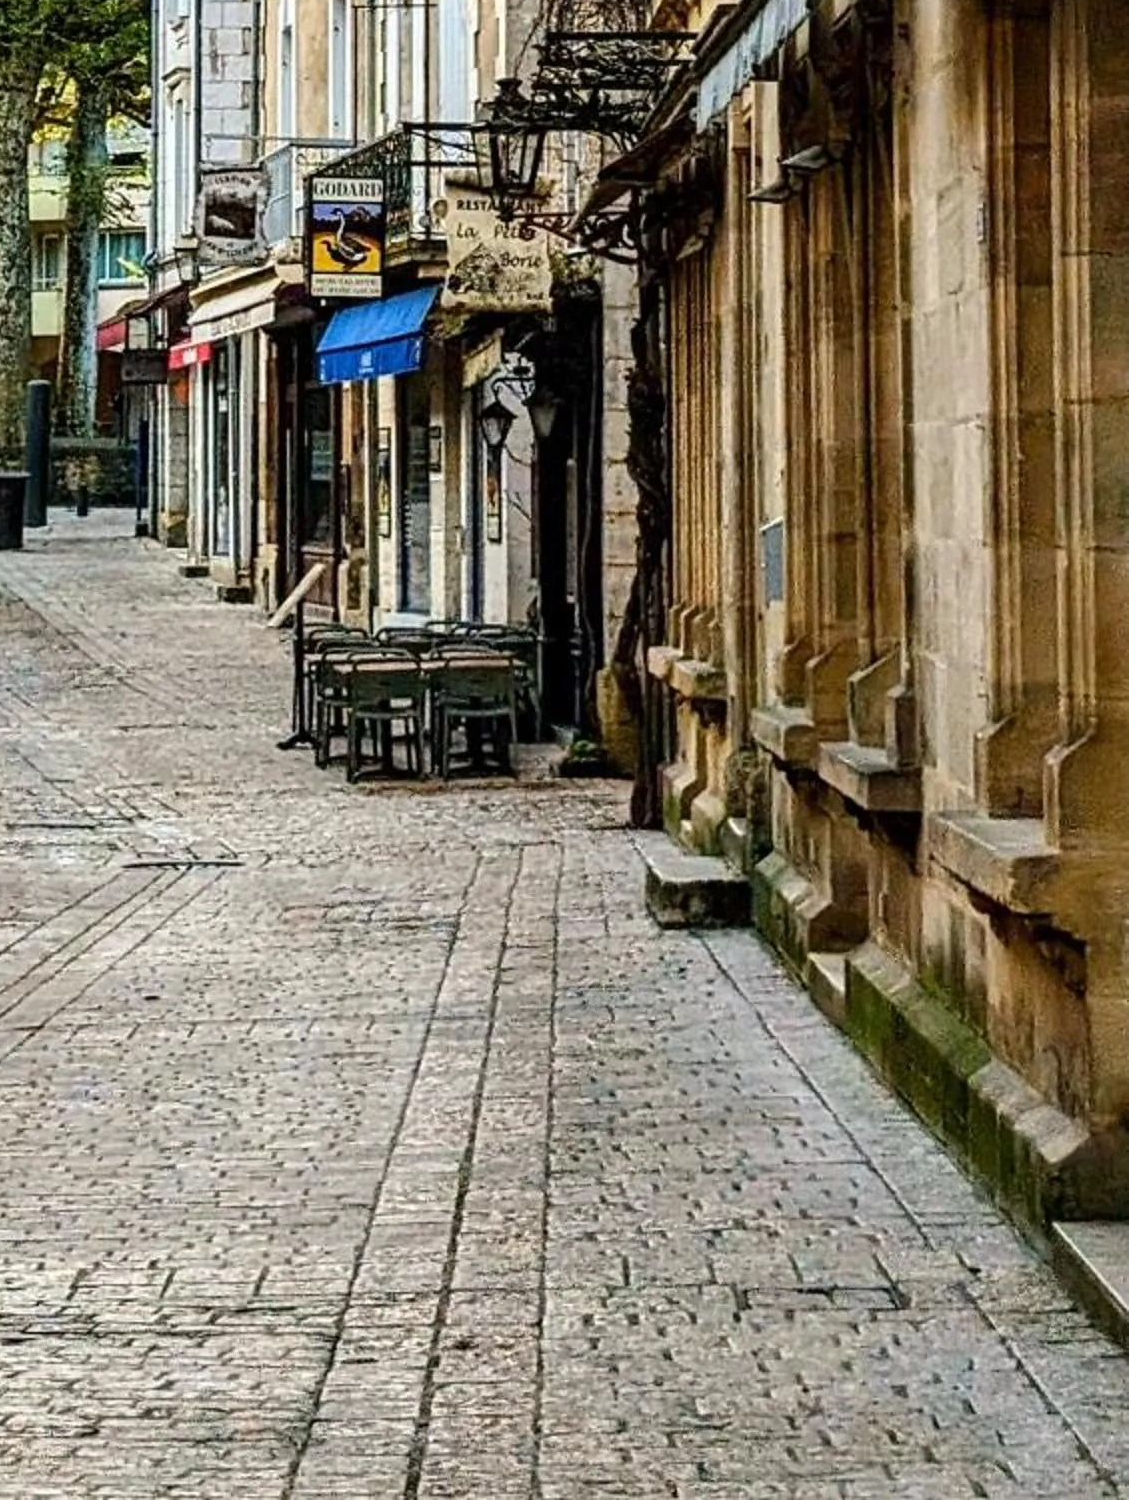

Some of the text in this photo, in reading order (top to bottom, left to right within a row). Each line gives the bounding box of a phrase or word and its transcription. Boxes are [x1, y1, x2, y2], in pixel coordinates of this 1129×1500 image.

[314, 181, 383, 198] GODARD
[456, 199, 543, 213] RESTAANT
[456, 222, 479, 239] La
